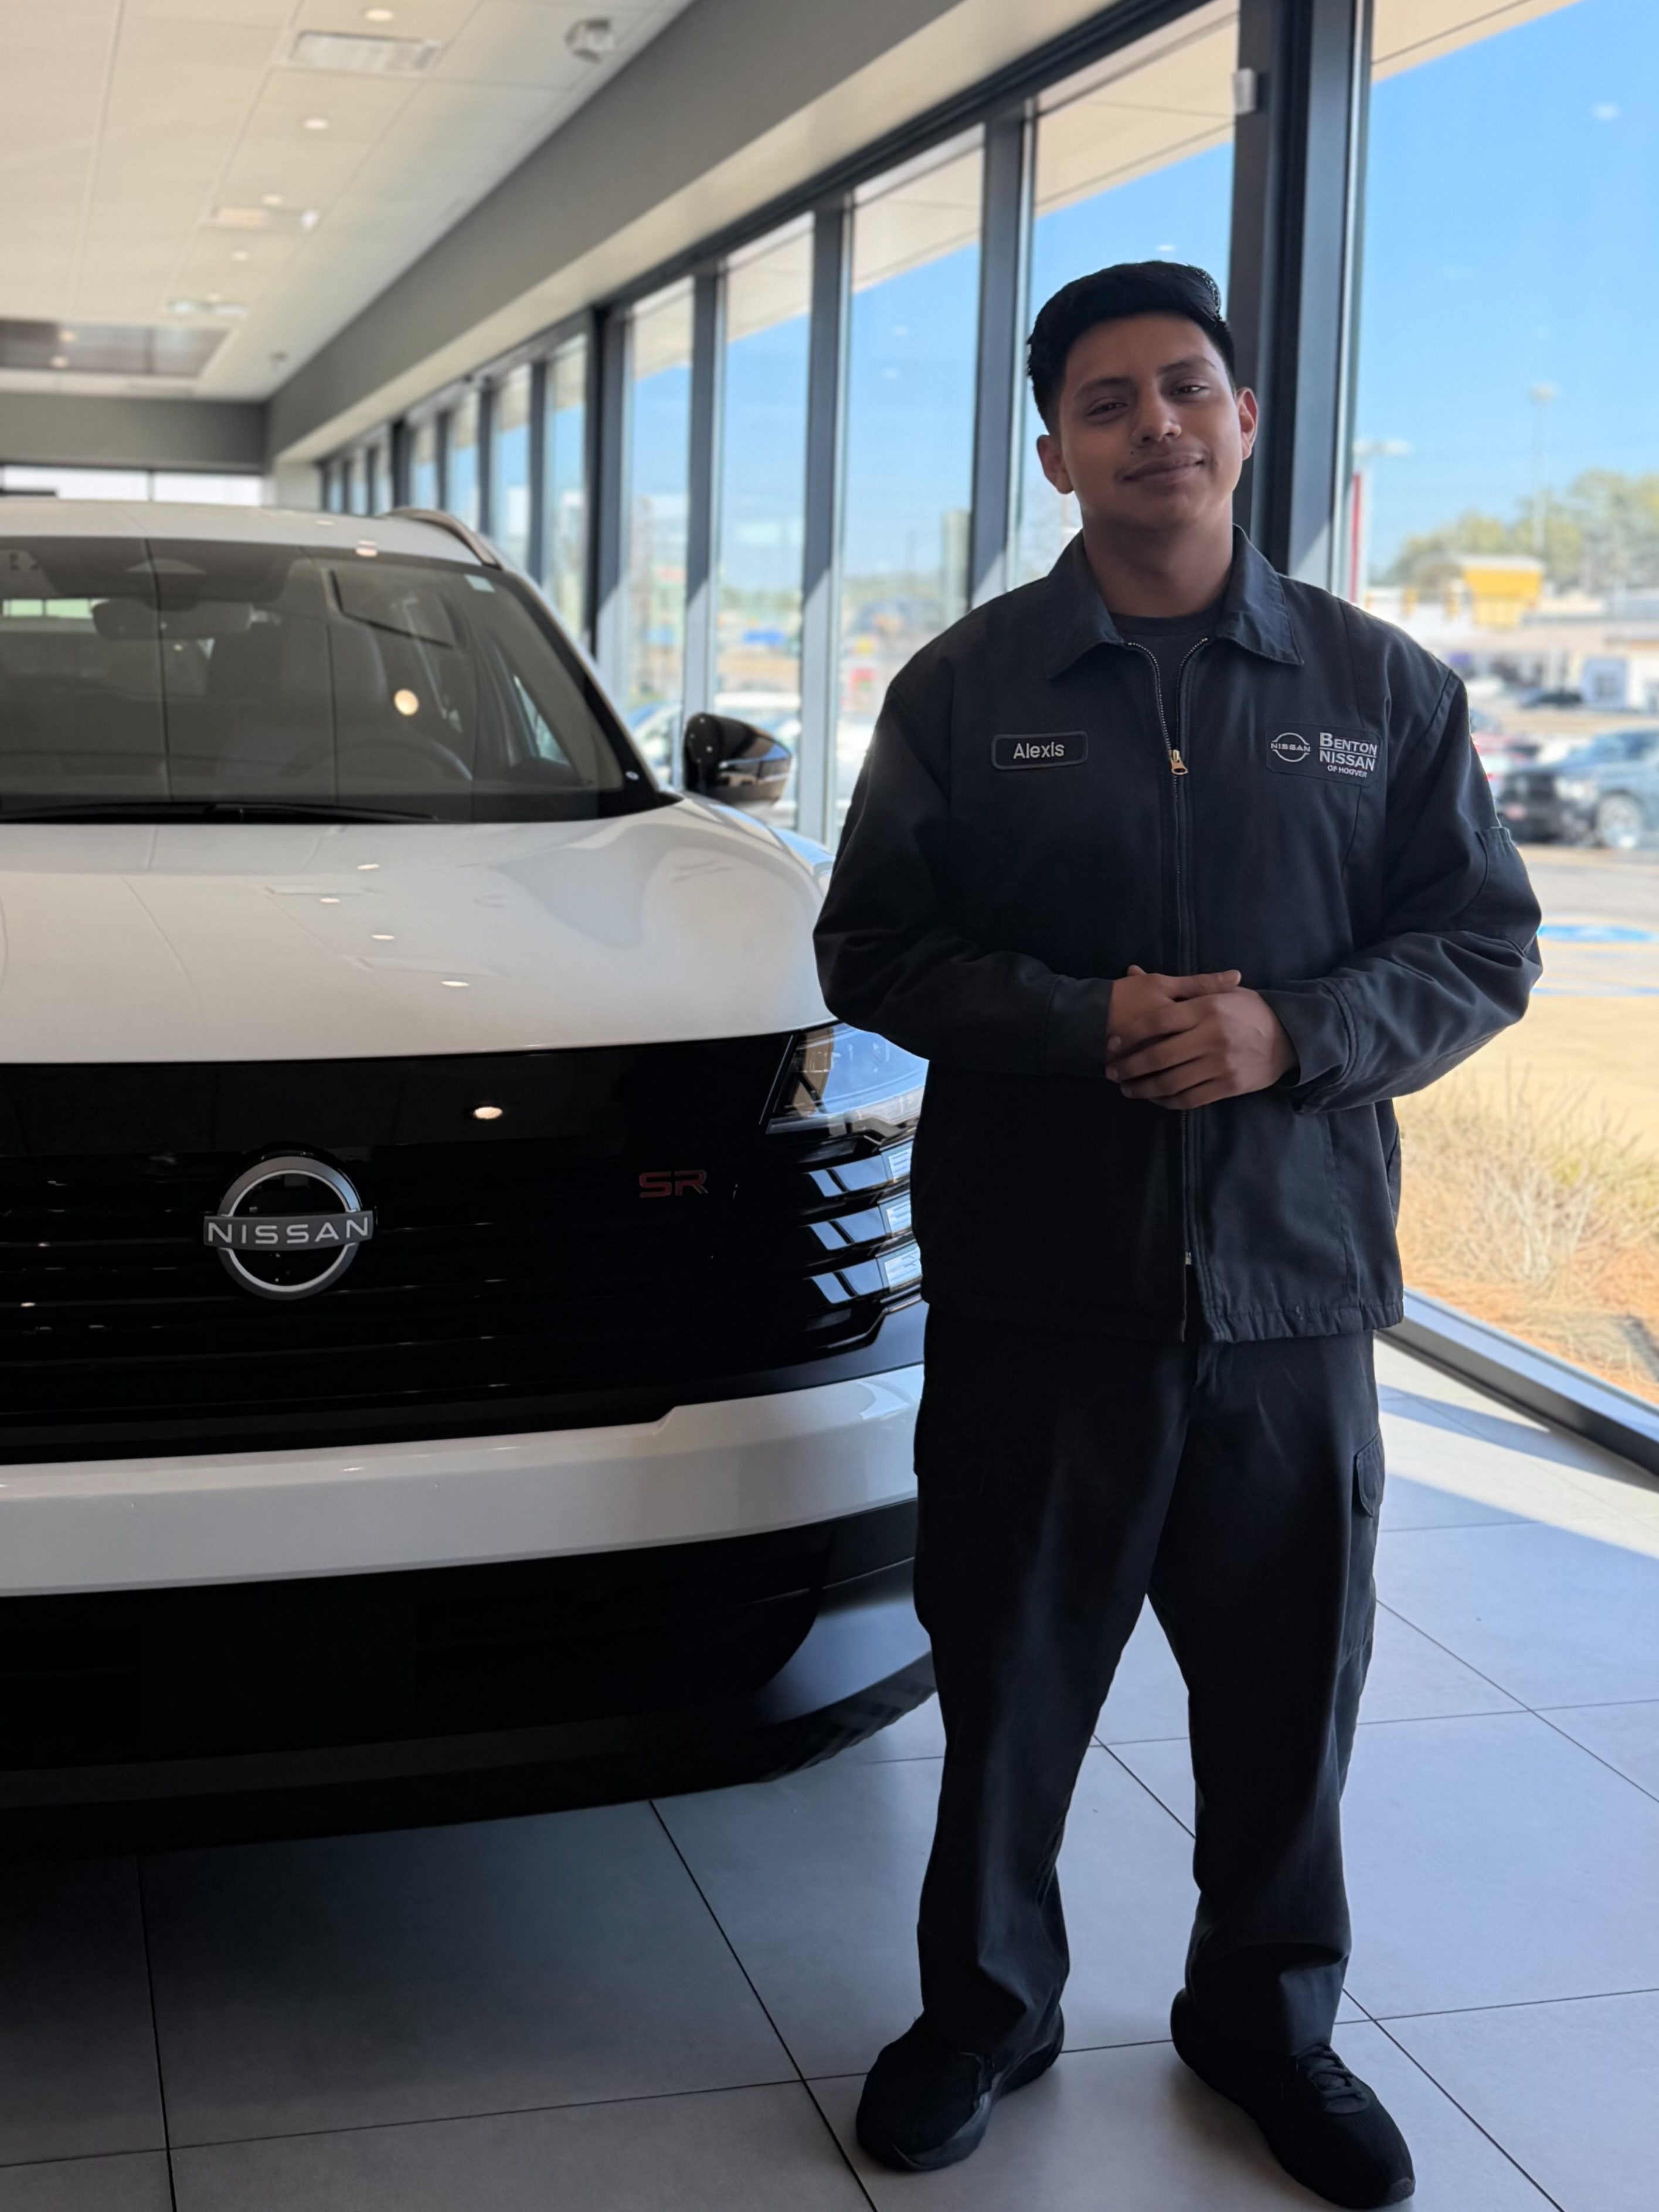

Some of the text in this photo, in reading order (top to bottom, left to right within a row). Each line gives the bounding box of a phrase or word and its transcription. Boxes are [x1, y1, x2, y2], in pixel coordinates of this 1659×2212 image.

[1013, 741, 1065, 759] Alexis
[1270, 742, 1311, 752] NISSAN
[1319, 732, 1377, 756] BENTON
[1319, 750, 1376, 771] NISSAN
[639, 1169, 708, 1198] SR
[208, 1217, 368, 1244] NISSAN
